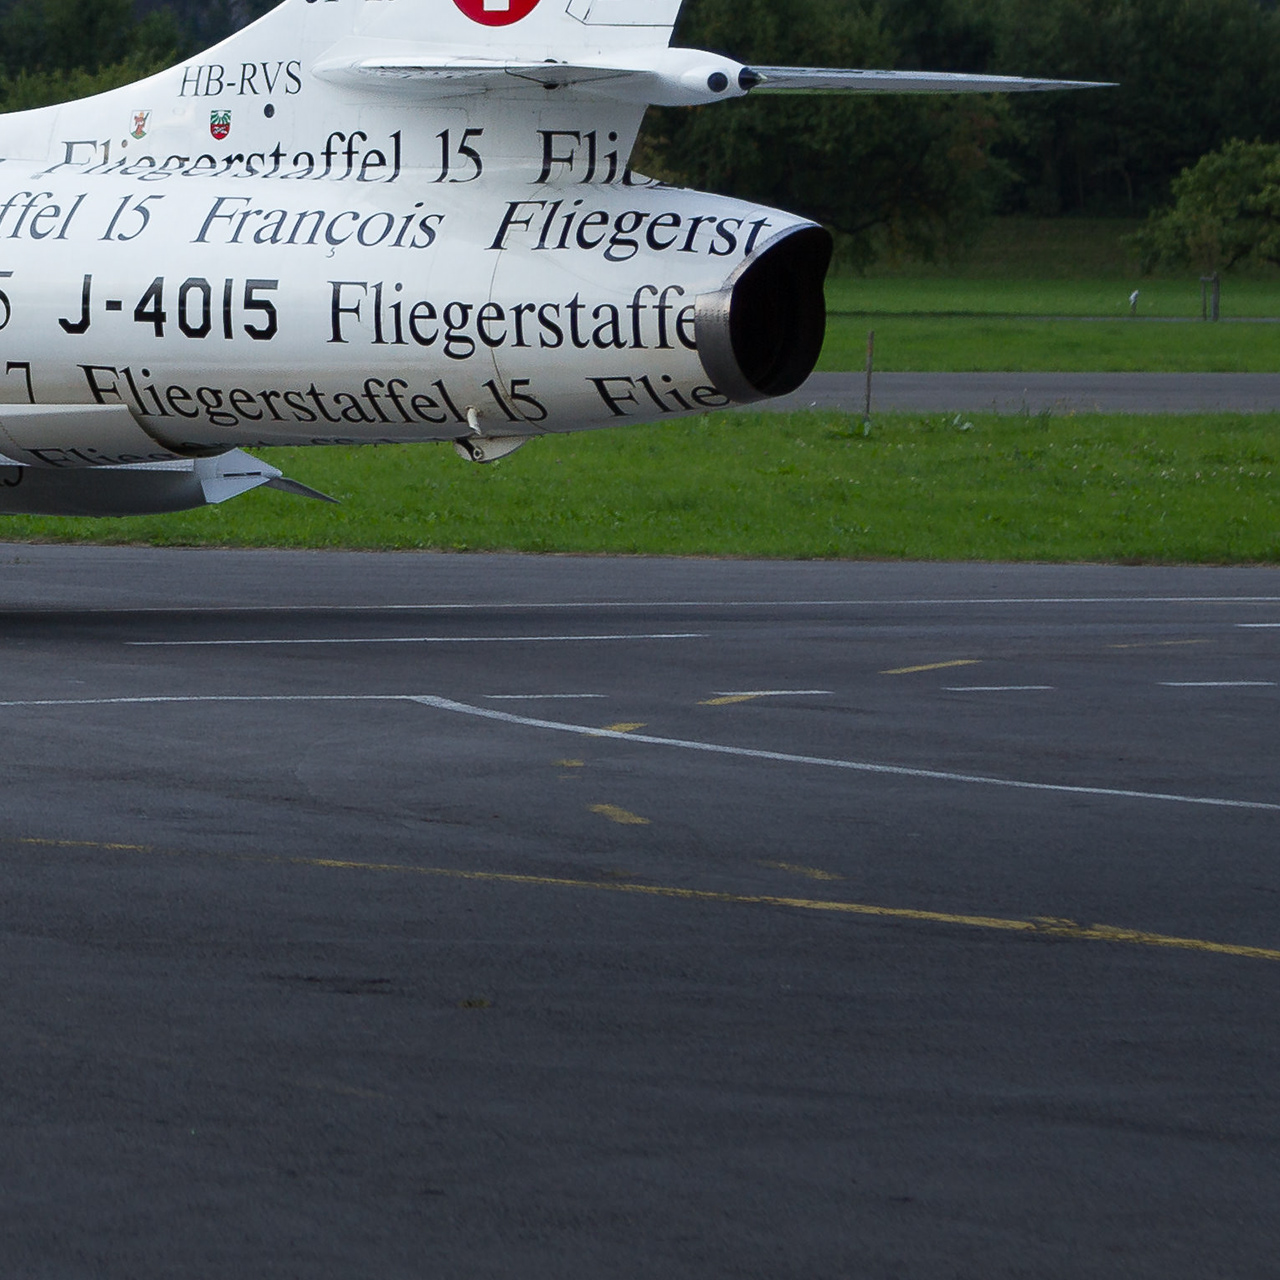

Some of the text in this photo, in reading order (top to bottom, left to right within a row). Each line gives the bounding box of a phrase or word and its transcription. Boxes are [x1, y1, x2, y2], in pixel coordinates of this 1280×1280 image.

[177, 60, 303, 97] HB-RVS
[42, 129, 403, 184] Fliegerstaffel
[428, 127, 485, 184] 15
[97, 193, 167, 242] 15
[189, 195, 446, 259] François
[483, 197, 773, 262] Fliegerst
[57, 273, 280, 341] J-4015
[326, 280, 698, 361] Fliegerstaffe
[5, 361, 36, 404] 7
[76, 363, 469, 428] Fliegerstaffel
[481, 377, 550, 423] 15
